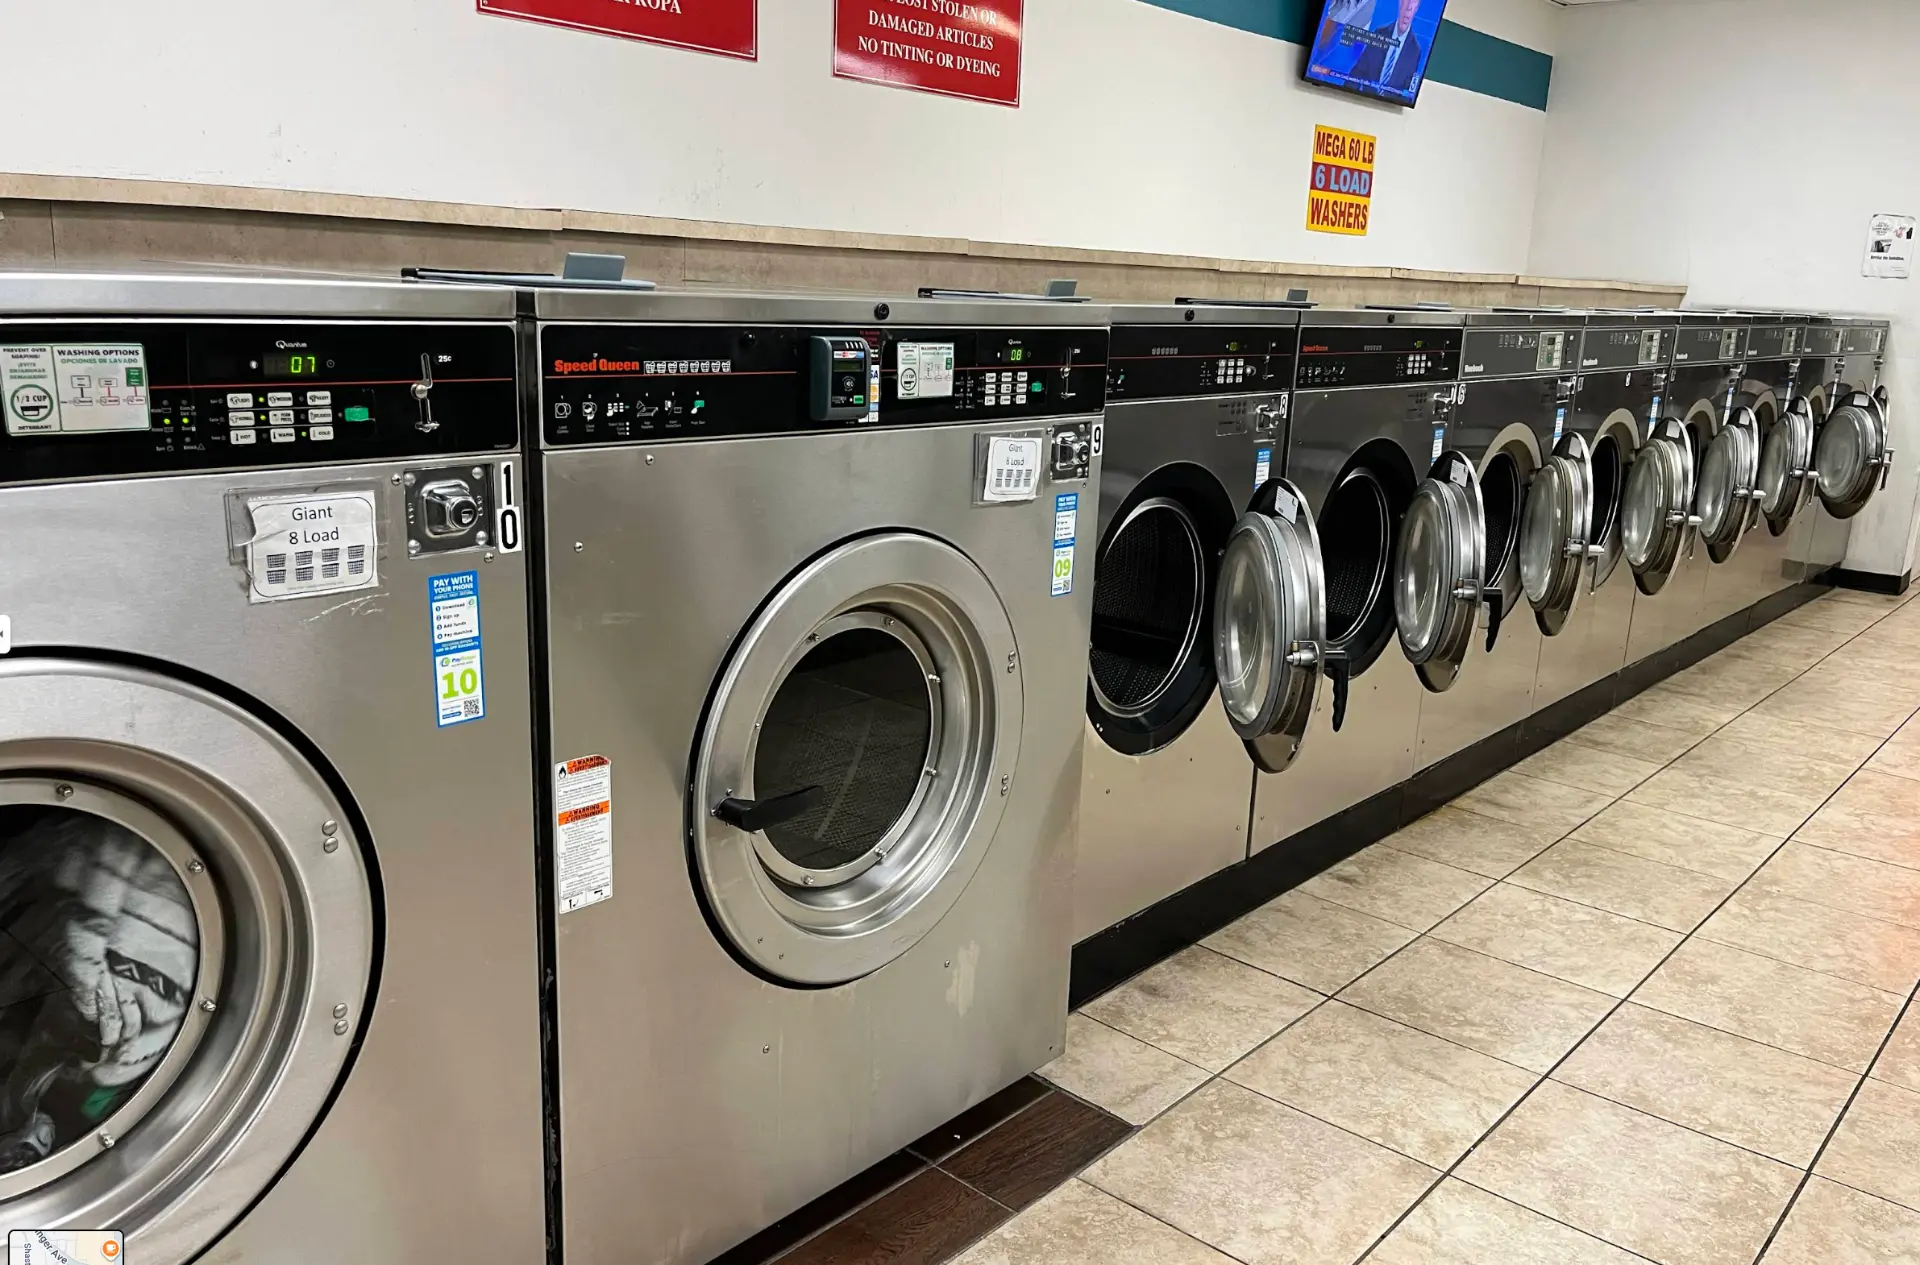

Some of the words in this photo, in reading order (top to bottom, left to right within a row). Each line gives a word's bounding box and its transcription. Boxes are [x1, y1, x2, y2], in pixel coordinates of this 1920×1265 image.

[896, 0, 928, 10] ST
[931, 0, 978, 22] STOLEN
[980, 9, 998, 26] OR
[868, 10, 934, 38] DAMAGED
[936, 26, 994, 50] ARTICLES
[858, 36, 878, 54] NO
[880, 40, 934, 65] TINTING
[936, 52, 954, 69] OR
[956, 56, 1001, 77] DYEING
[1315, 131, 1346, 159] MEGA
[1348, 138, 1360, 162] 60
[1362, 141, 1375, 164] LB
[1315, 165, 1326, 189] 6
[1329, 167, 1370, 195] LOAD
[1310, 197, 1368, 230] WASHERS
[291, 356, 316, 373] 07
[554, 359, 597, 375] Speed
[599, 358, 640, 371] Queen
[1008, 443, 1024, 453] Giant
[1093, 426, 1101, 454] 9
[1010, 458, 1025, 466] Load
[291, 506, 333, 522] Giant
[289, 531, 299, 545] 8
[303, 528, 339, 544] Load
[1055, 558, 1071, 578] 09
[433, 578, 449, 588] PAY
[451, 575, 473, 585] WITH
[434, 586, 452, 594] YOUR
[453, 583, 473, 591] PHONE
[442, 668, 477, 699] 10
[573, 803, 600, 815] WARNING
